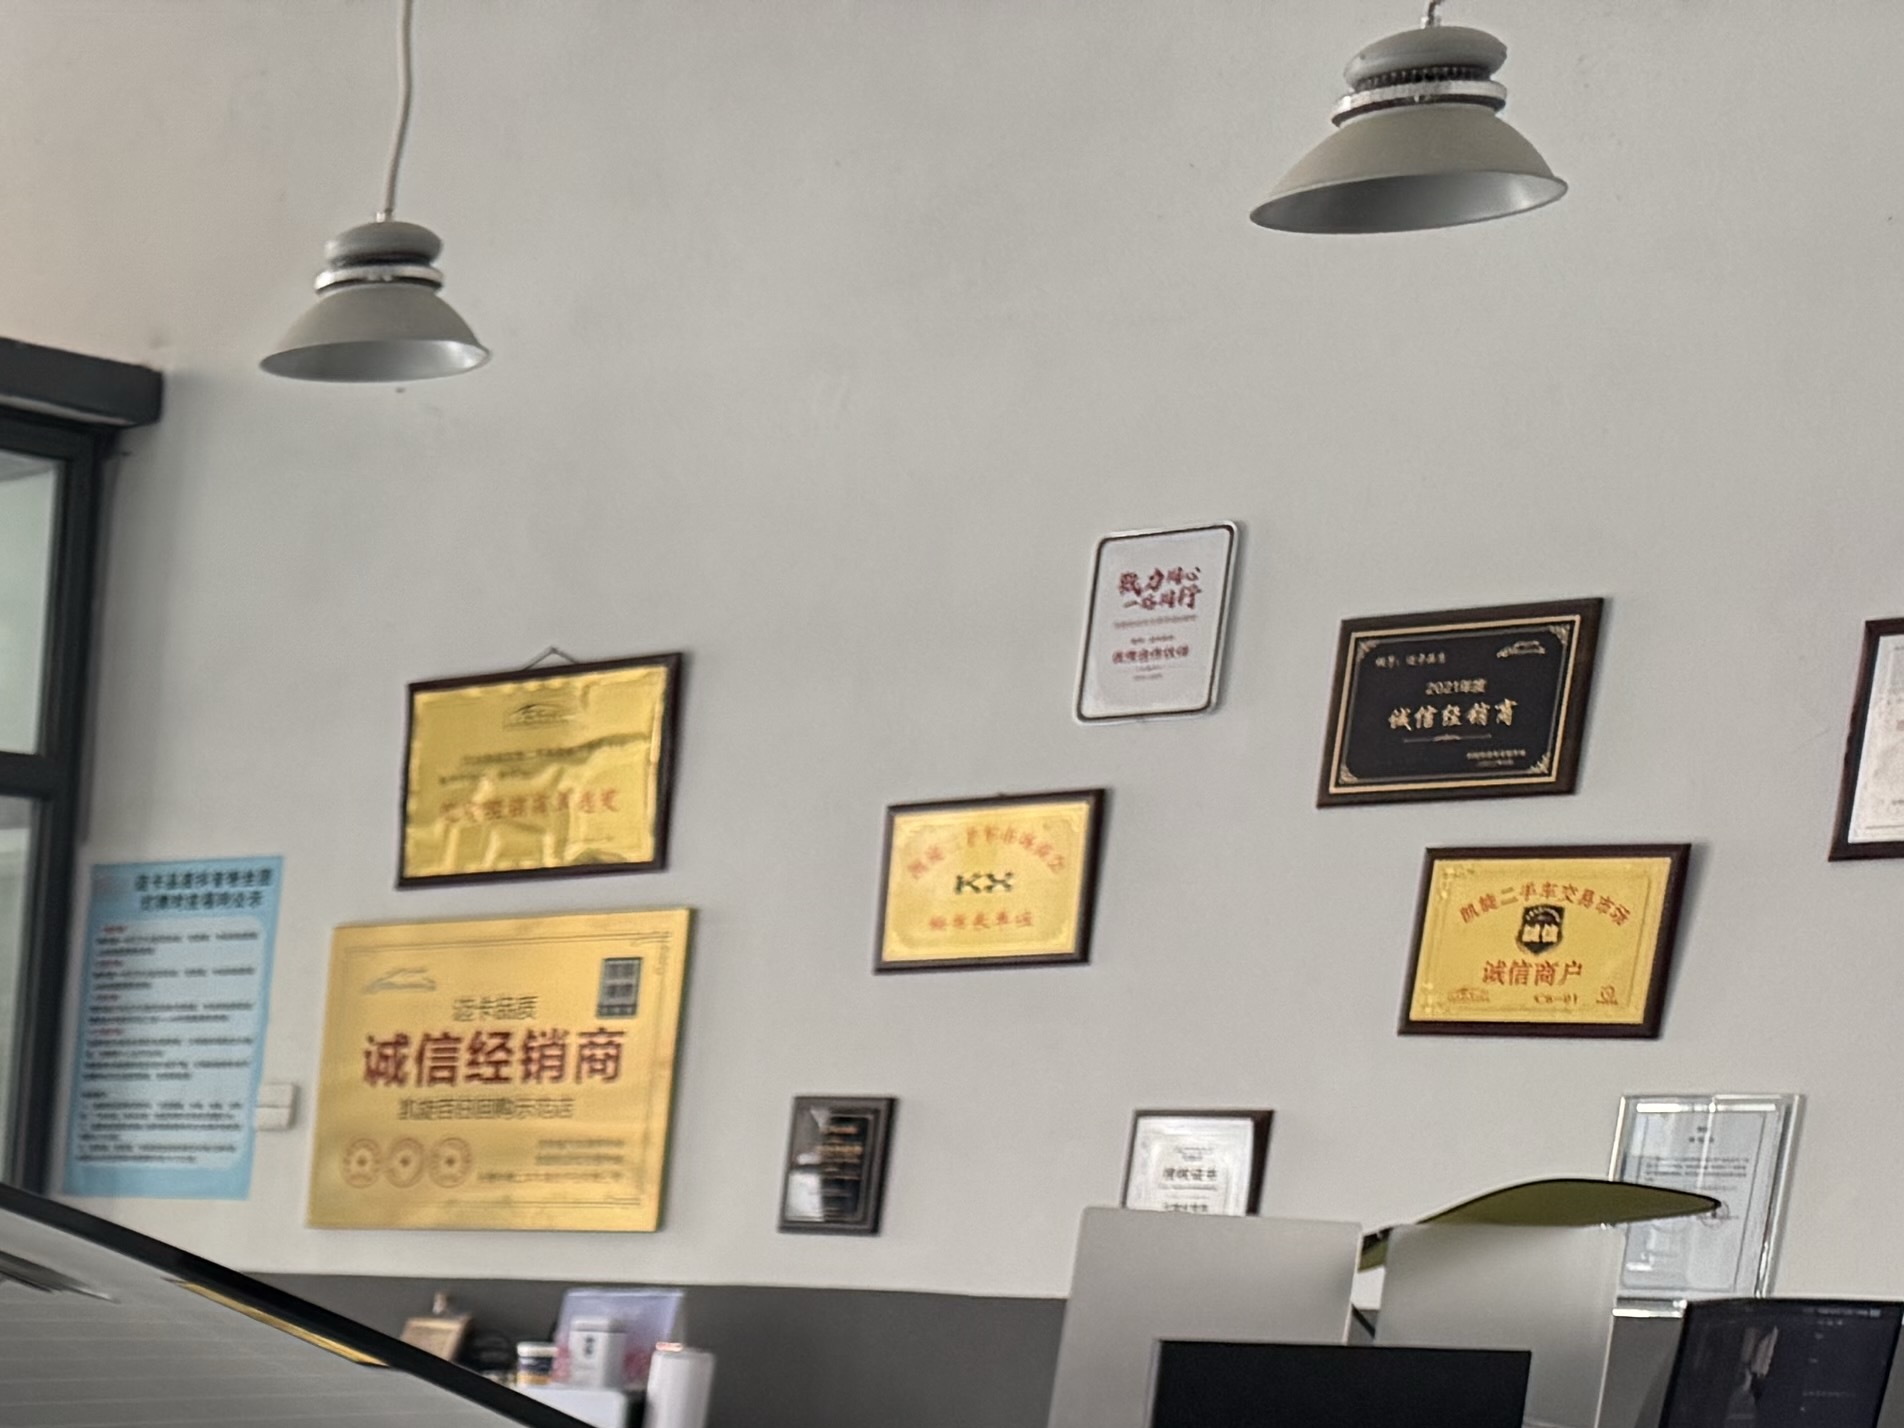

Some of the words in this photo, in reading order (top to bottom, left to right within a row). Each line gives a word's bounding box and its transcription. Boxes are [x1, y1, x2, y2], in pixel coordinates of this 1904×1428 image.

[1388, 698, 1518, 731] 诚信经销商
[1483, 960, 1584, 987] 诚信商户
[362, 1027, 627, 1087] 诚信经销商
